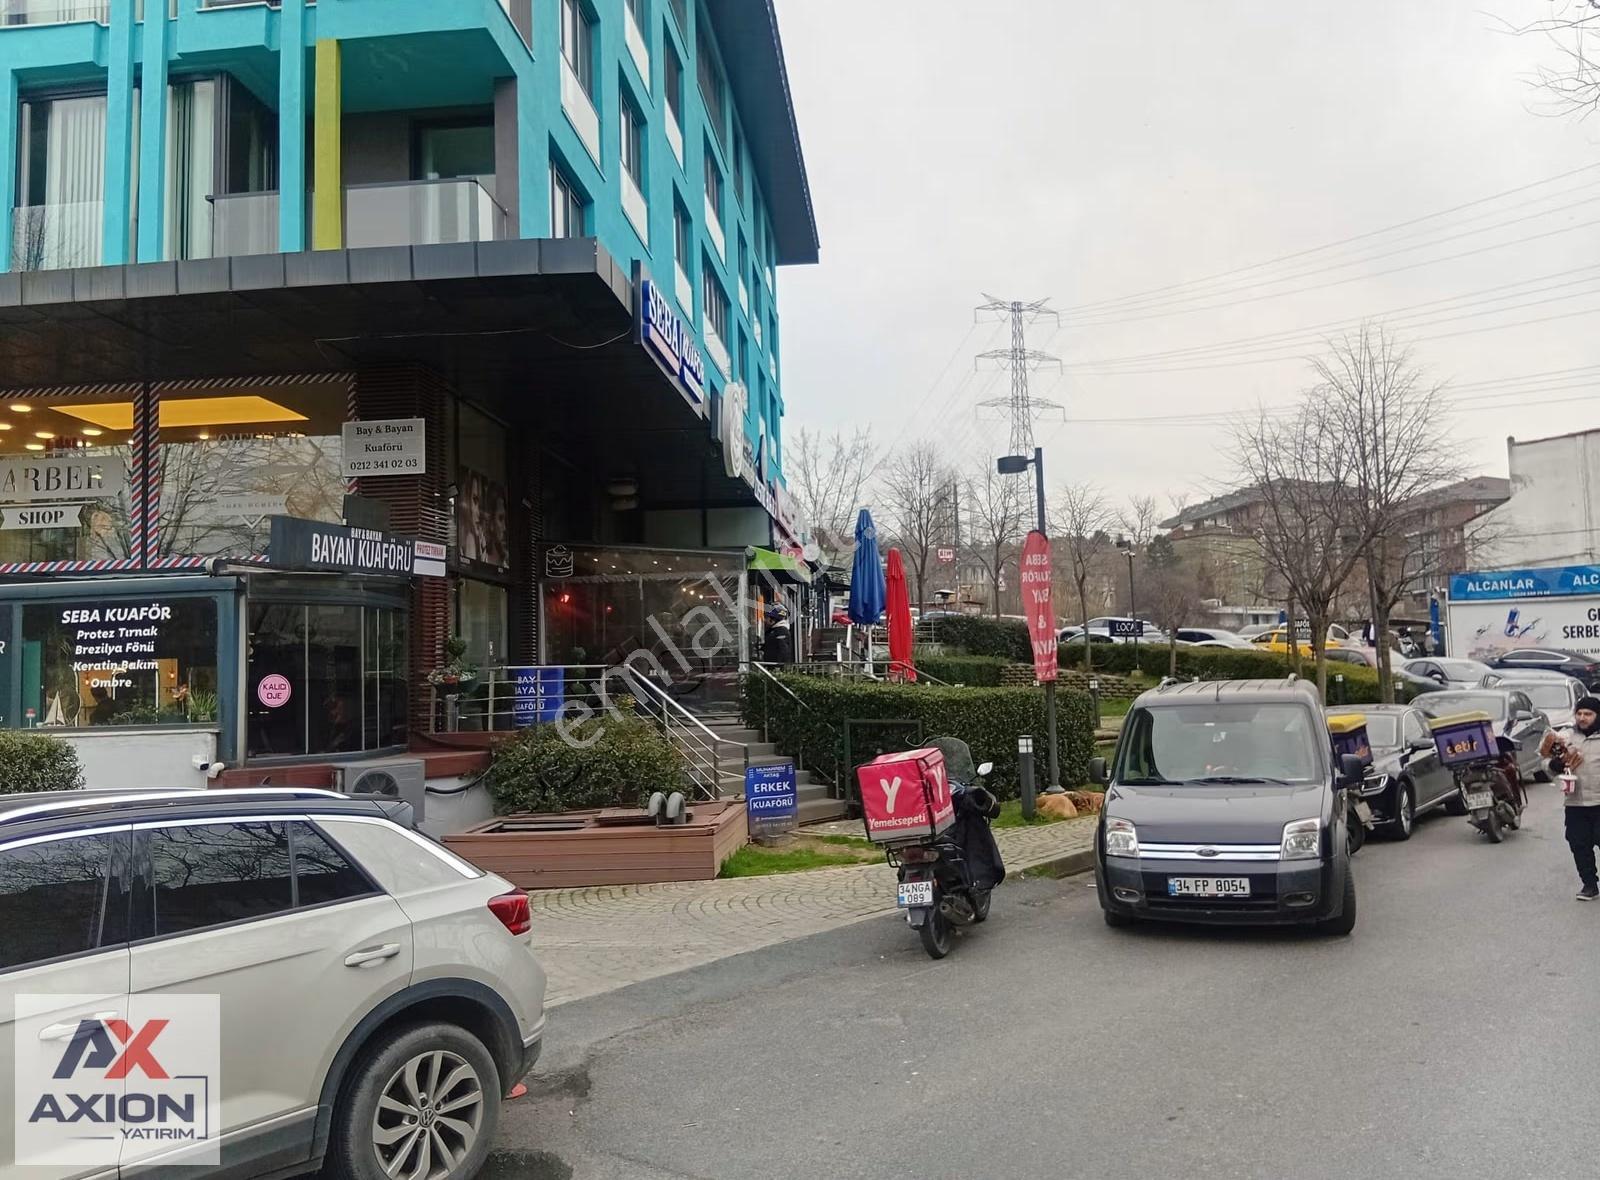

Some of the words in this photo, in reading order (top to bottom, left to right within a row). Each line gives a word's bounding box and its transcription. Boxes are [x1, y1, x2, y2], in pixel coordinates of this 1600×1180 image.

[648, 279, 680, 361] SEBA
[356, 427, 373, 436] Bay
[375, 425, 382, 434] &
[385, 425, 414, 435] Bayan
[350, 461, 371, 470] 0212
[373, 460, 389, 469] 341
[391, 459, 403, 468] 02
[405, 459, 418, 467] 03
[19, 510, 64, 525] SHOP
[312, 533, 354, 565] BAYAN
[358, 539, 412, 571] KUAFÖRÜ
[1467, 579, 1534, 592] ALCANLAR
[62, 609, 101, 624] SEBA
[105, 604, 172, 622] KUAFÖR
[77, 629, 115, 640] Protez
[75, 643, 123, 655] Brezilya
[125, 641, 155, 653] Fönü
[73, 660, 118, 672] Keratin
[90, 678, 132, 688] Ombre
[517, 675, 536, 684] BAY
[754, 781, 790, 793] ERKEK
[753, 796, 793, 809] KUAFÖRÜ
[869, 813, 926, 829] Yemeksepeti
[1176, 879, 1190, 891] 34
[1194, 879, 1209, 892] FP
[1215, 879, 1246, 892] 8054
[907, 893, 925, 903] 089
